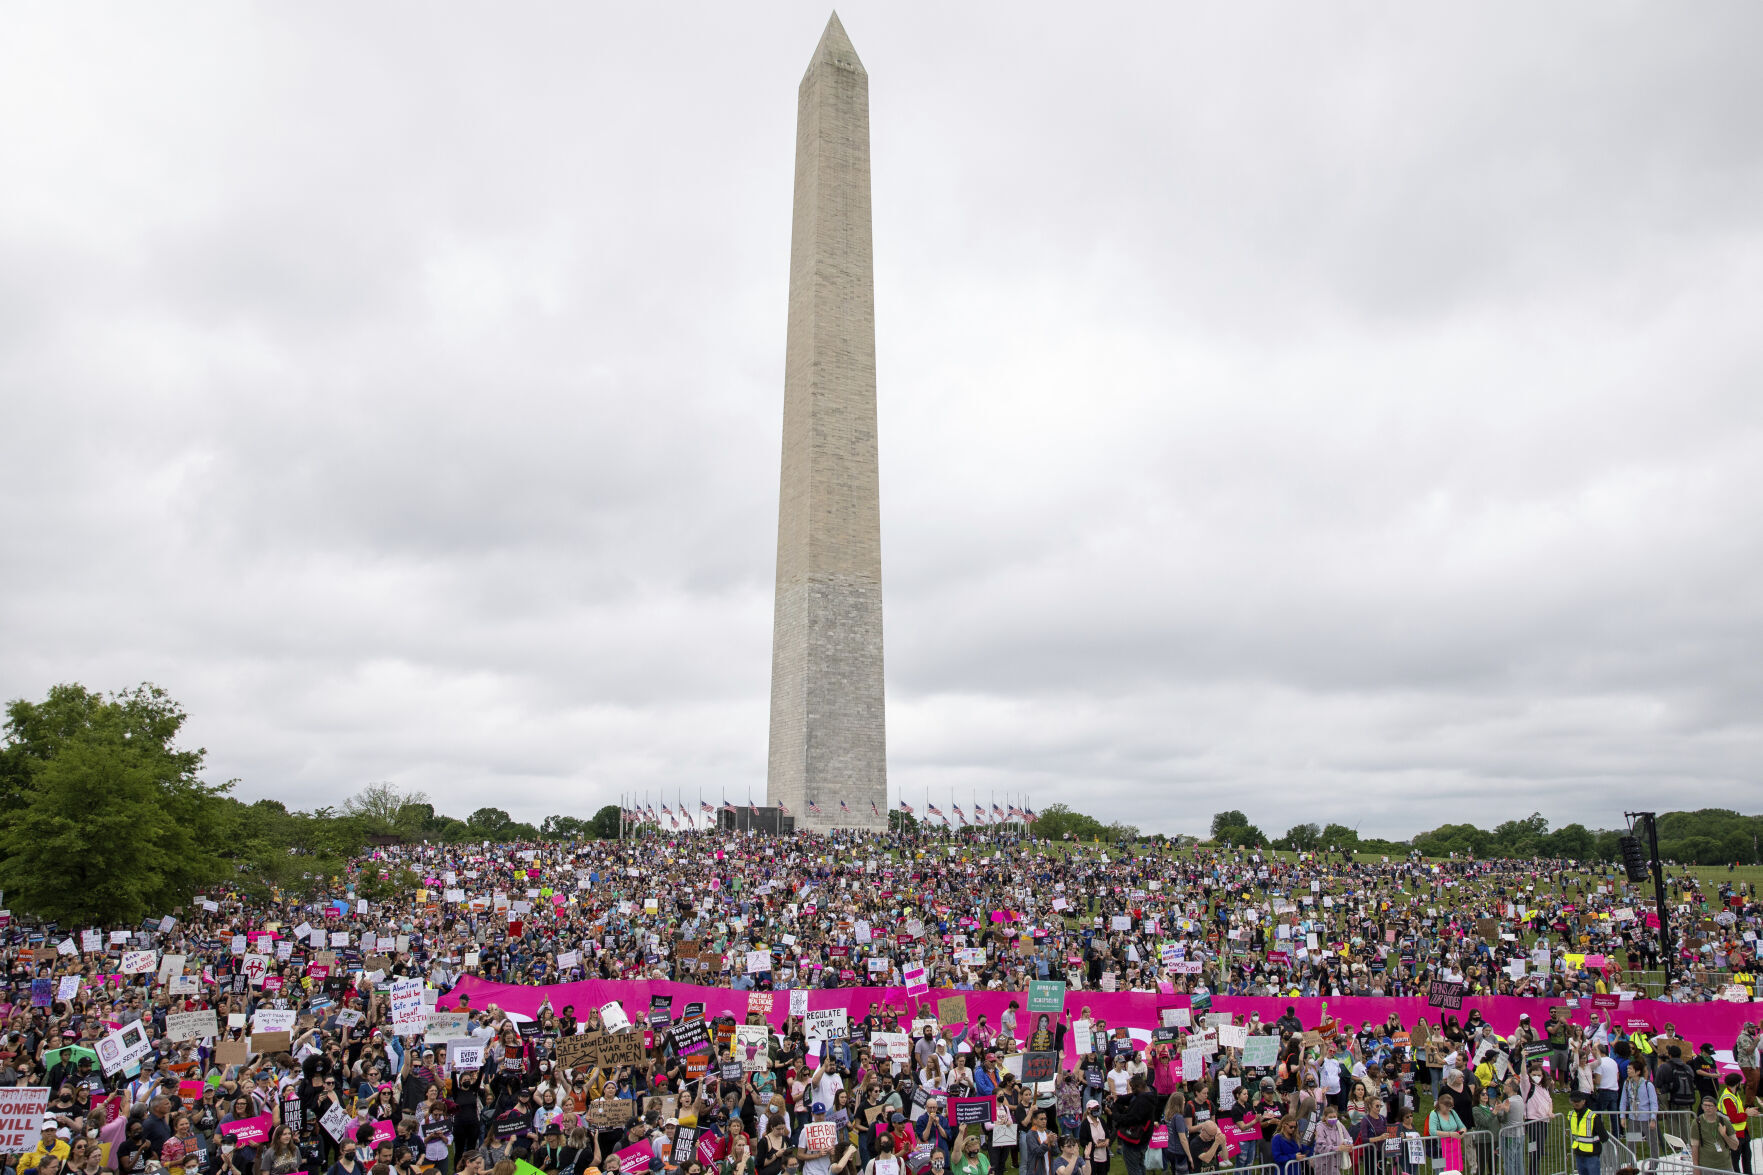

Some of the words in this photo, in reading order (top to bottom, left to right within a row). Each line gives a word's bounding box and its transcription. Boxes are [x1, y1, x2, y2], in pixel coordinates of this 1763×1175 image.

[1432, 982, 1448, 994] BANS
[1448, 984, 1463, 995] OFF
[393, 993, 412, 1001] Should
[1430, 994, 1443, 1005] OUR
[1443, 995, 1461, 1008] BODIES
[394, 1002, 407, 1011] Safe
[806, 1009, 841, 1020] REGULATE
[816, 1020, 834, 1028] YOUR
[182, 1030, 201, 1039] ROE
[570, 1034, 589, 1043] NEED
[597, 1035, 615, 1046] END
[616, 1033, 637, 1042] THE
[557, 1043, 580, 1054] SAFE
[599, 1044, 621, 1053] WAR
[626, 1042, 641, 1051] ON
[677, 1040, 709, 1057] VAGINA
[123, 1049, 140, 1064] SENT
[140, 1043, 150, 1053] US
[461, 1050, 479, 1058] EVERY
[604, 1051, 642, 1065] WOMEN
[1025, 1068, 1053, 1077] ALITO
[0, 1103, 47, 1115] OMEN
[285, 1100, 301, 1111] HOW
[285, 1110, 303, 1121] DARE
[229, 1126, 250, 1134] Abortion
[679, 1127, 695, 1139] HOW
[807, 1125, 824, 1138] HER
[676, 1139, 693, 1151] DARE
[808, 1138, 825, 1151] HER
[635, 1155, 650, 1163] Care.
[674, 1150, 691, 1161] THEY
